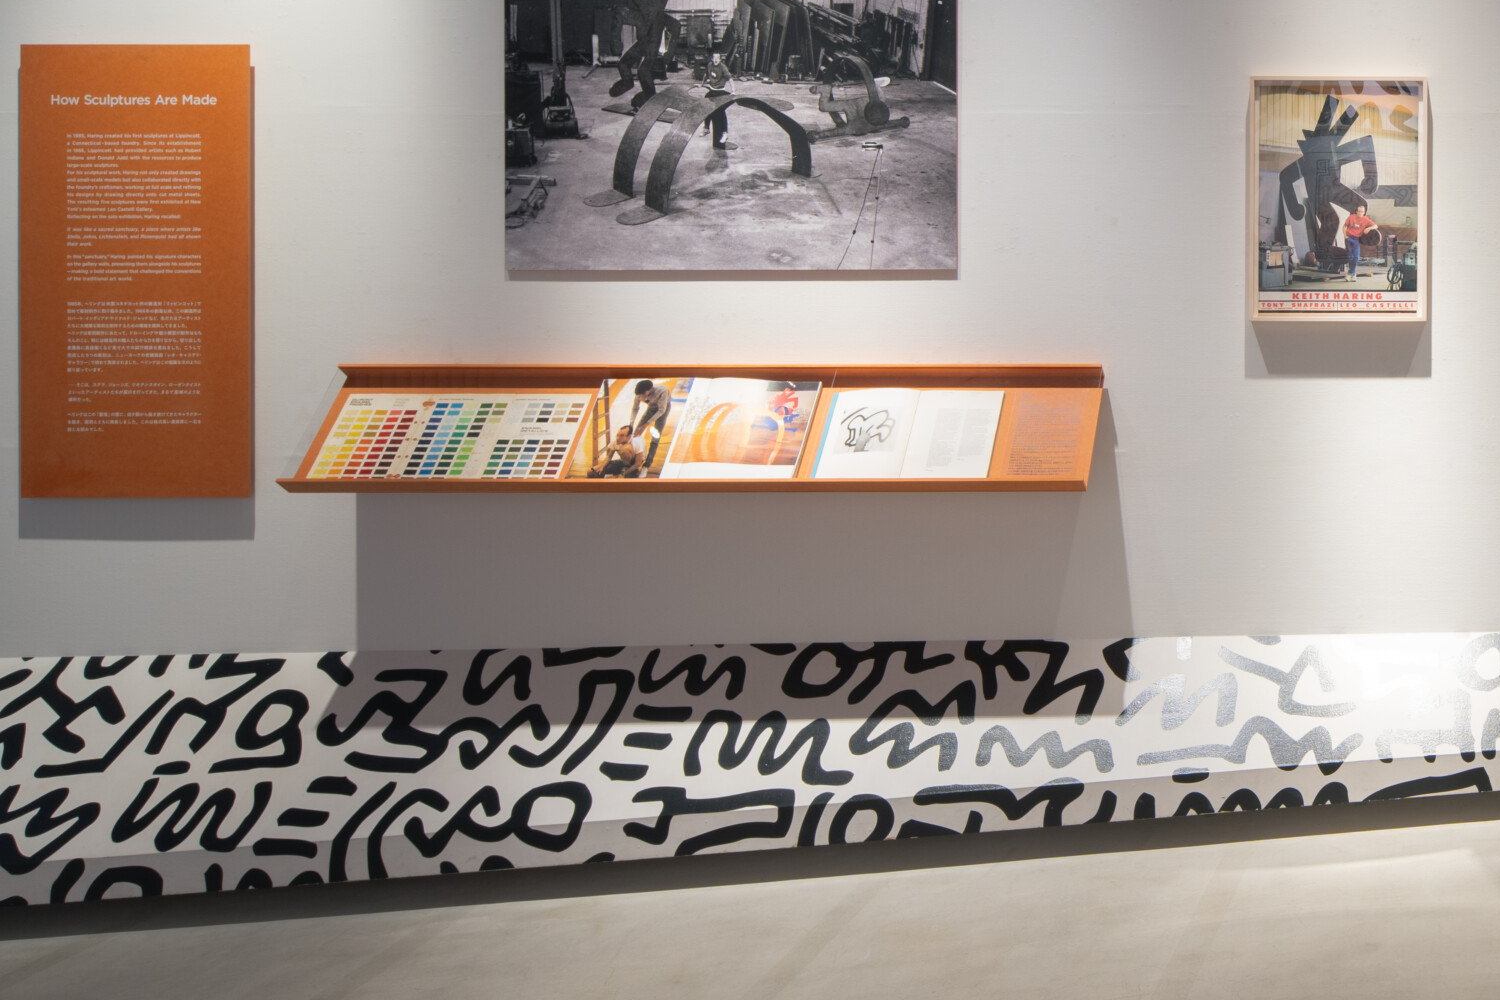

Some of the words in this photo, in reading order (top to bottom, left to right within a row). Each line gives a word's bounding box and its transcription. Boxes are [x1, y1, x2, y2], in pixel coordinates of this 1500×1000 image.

[51, 94, 79, 105] How
[84, 94, 150, 107] Sculptures
[155, 94, 177, 105] Are
[182, 94, 217, 105] Made
